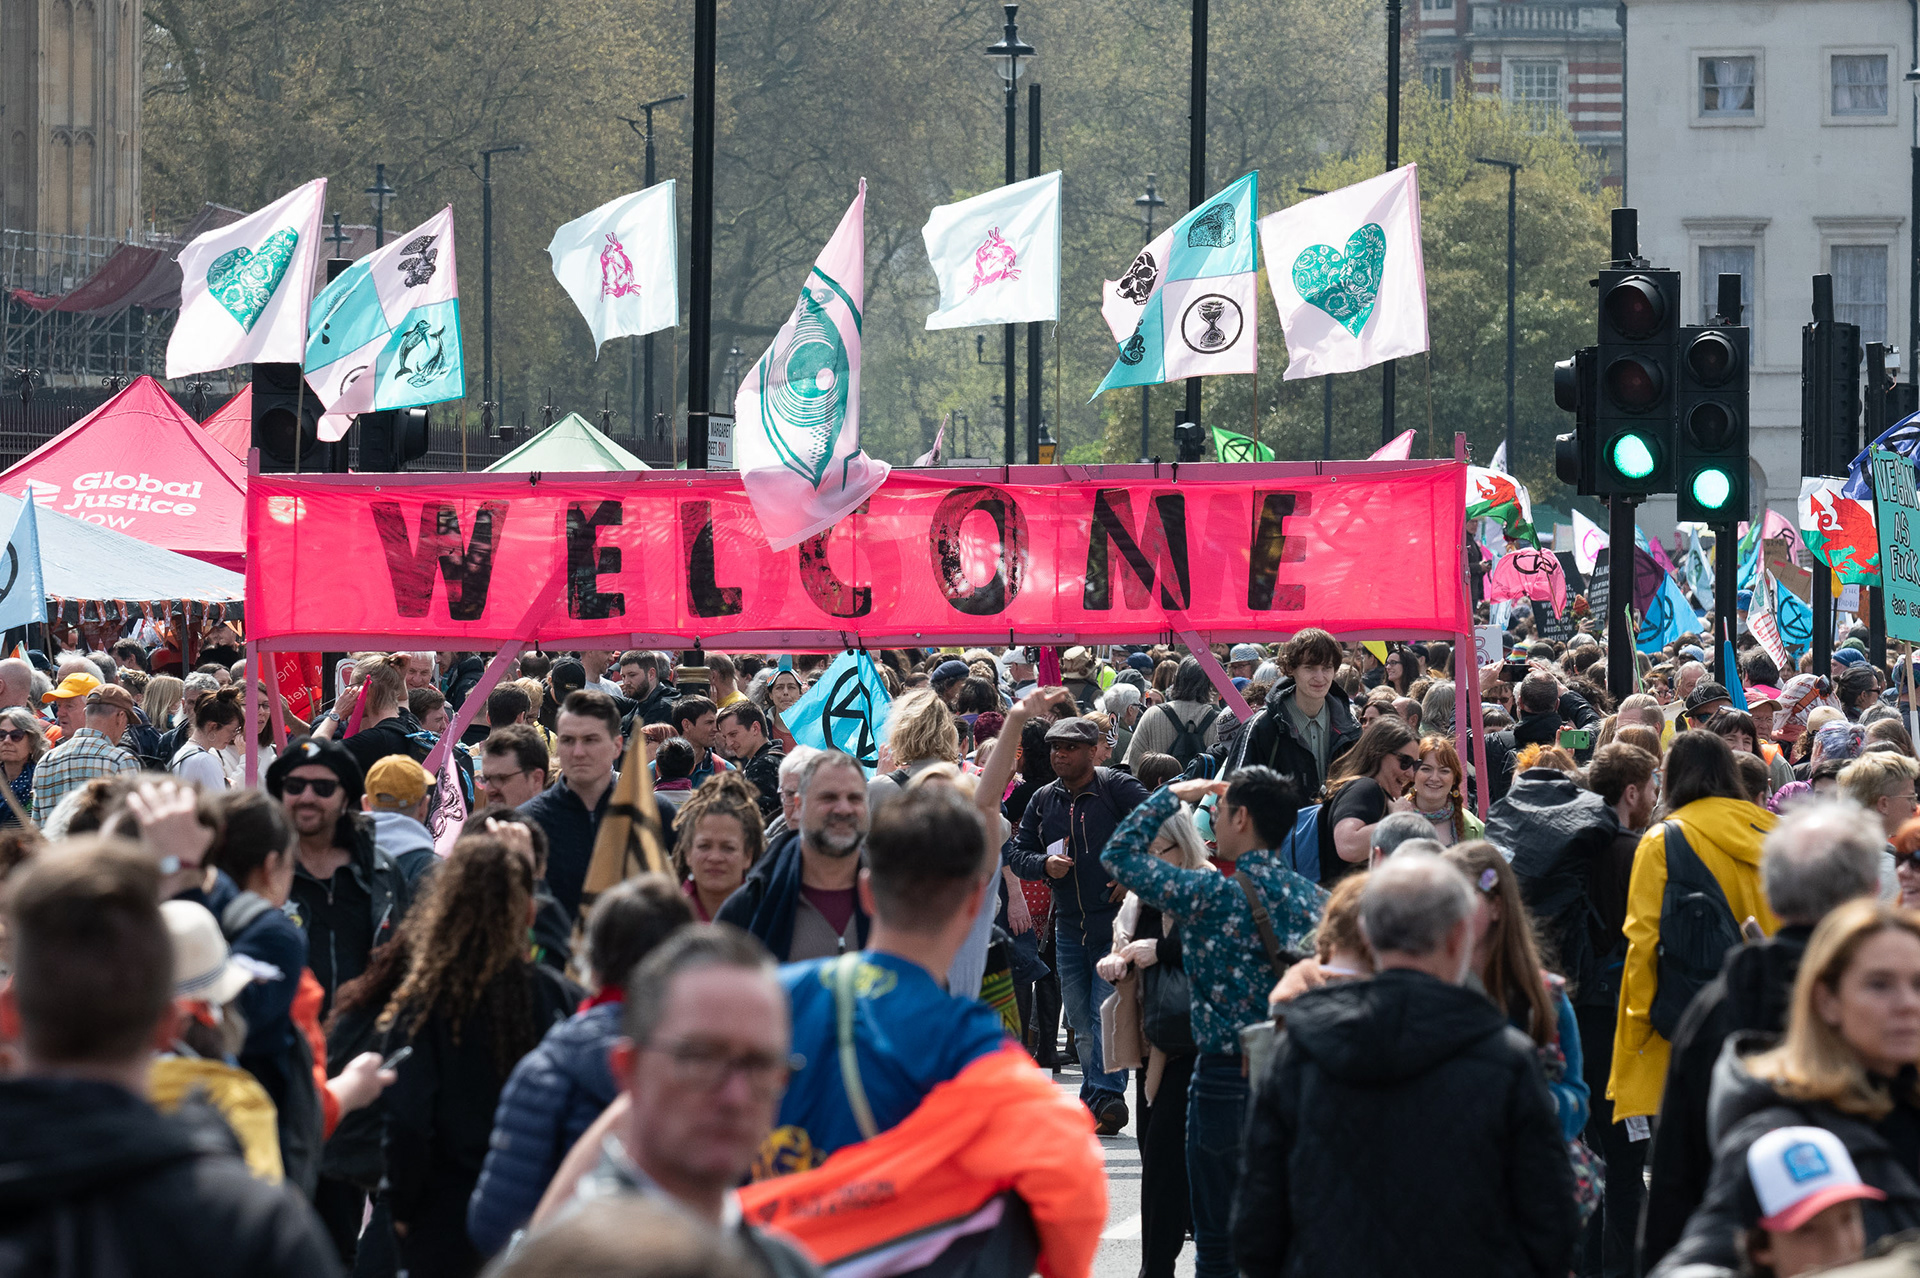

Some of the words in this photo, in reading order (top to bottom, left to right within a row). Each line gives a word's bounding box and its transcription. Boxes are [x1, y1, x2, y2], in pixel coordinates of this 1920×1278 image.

[710, 421, 731, 438] MARGARET
[72, 471, 203, 499] Global
[1874, 458, 1920, 511] VEGAN
[63, 492, 197, 516] Justice
[1894, 511, 1910, 548] AS
[369, 486, 1312, 620] WELCOME
[1753, 613, 1788, 668] CLIMATE
